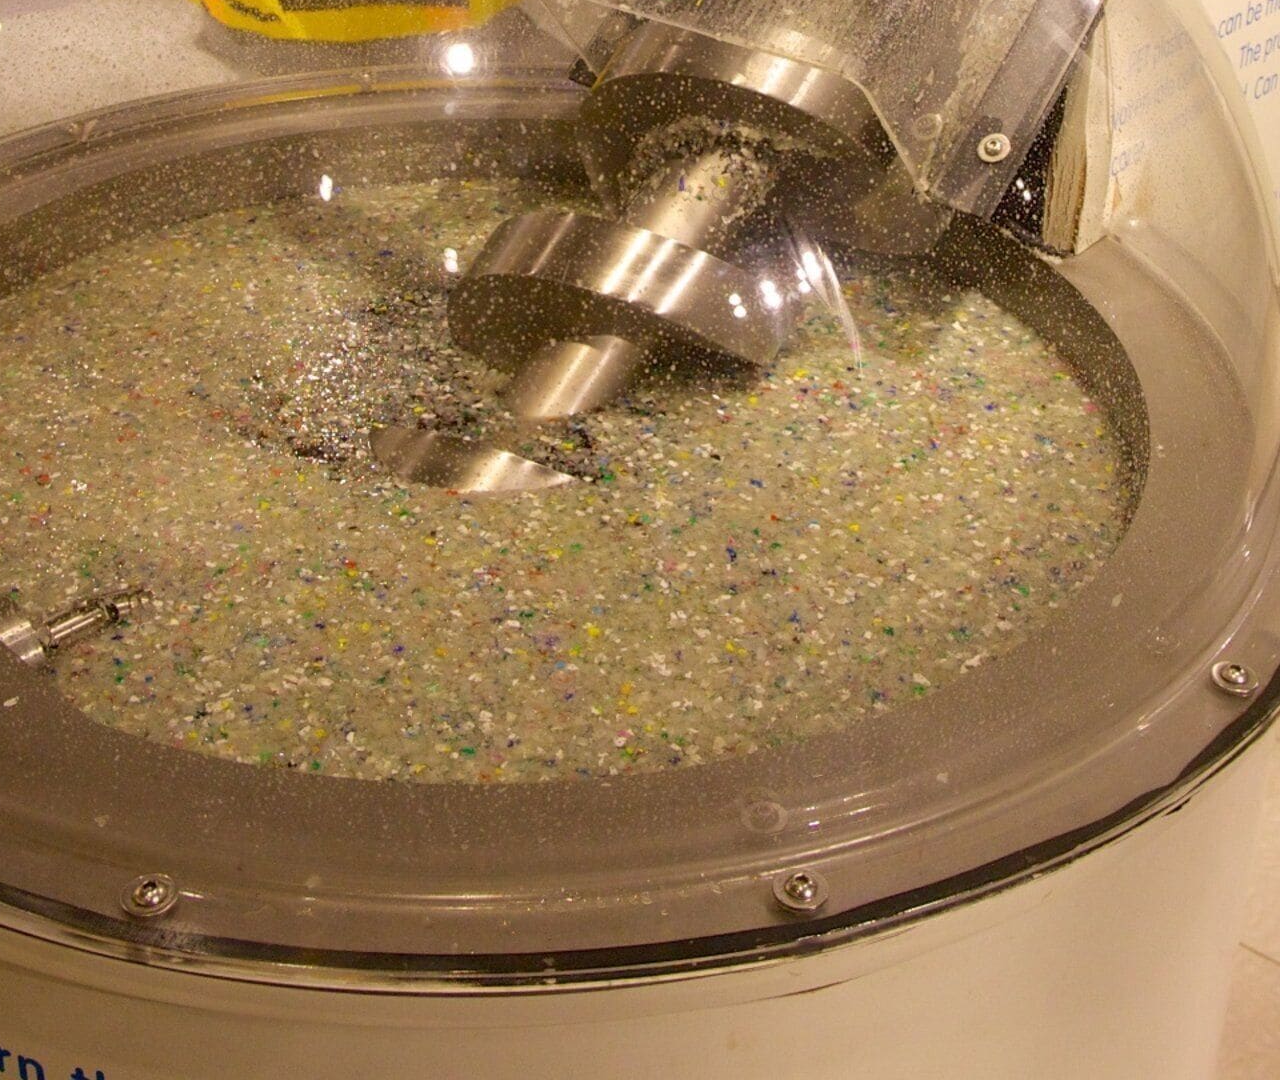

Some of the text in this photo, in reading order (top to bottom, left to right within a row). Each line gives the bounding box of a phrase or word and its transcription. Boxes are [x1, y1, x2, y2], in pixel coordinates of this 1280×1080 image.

[1218, 11, 1242, 39] can
[1246, 0, 1263, 26] be
[1239, 42, 1262, 69] The
[1253, 72, 1278, 100] Can
